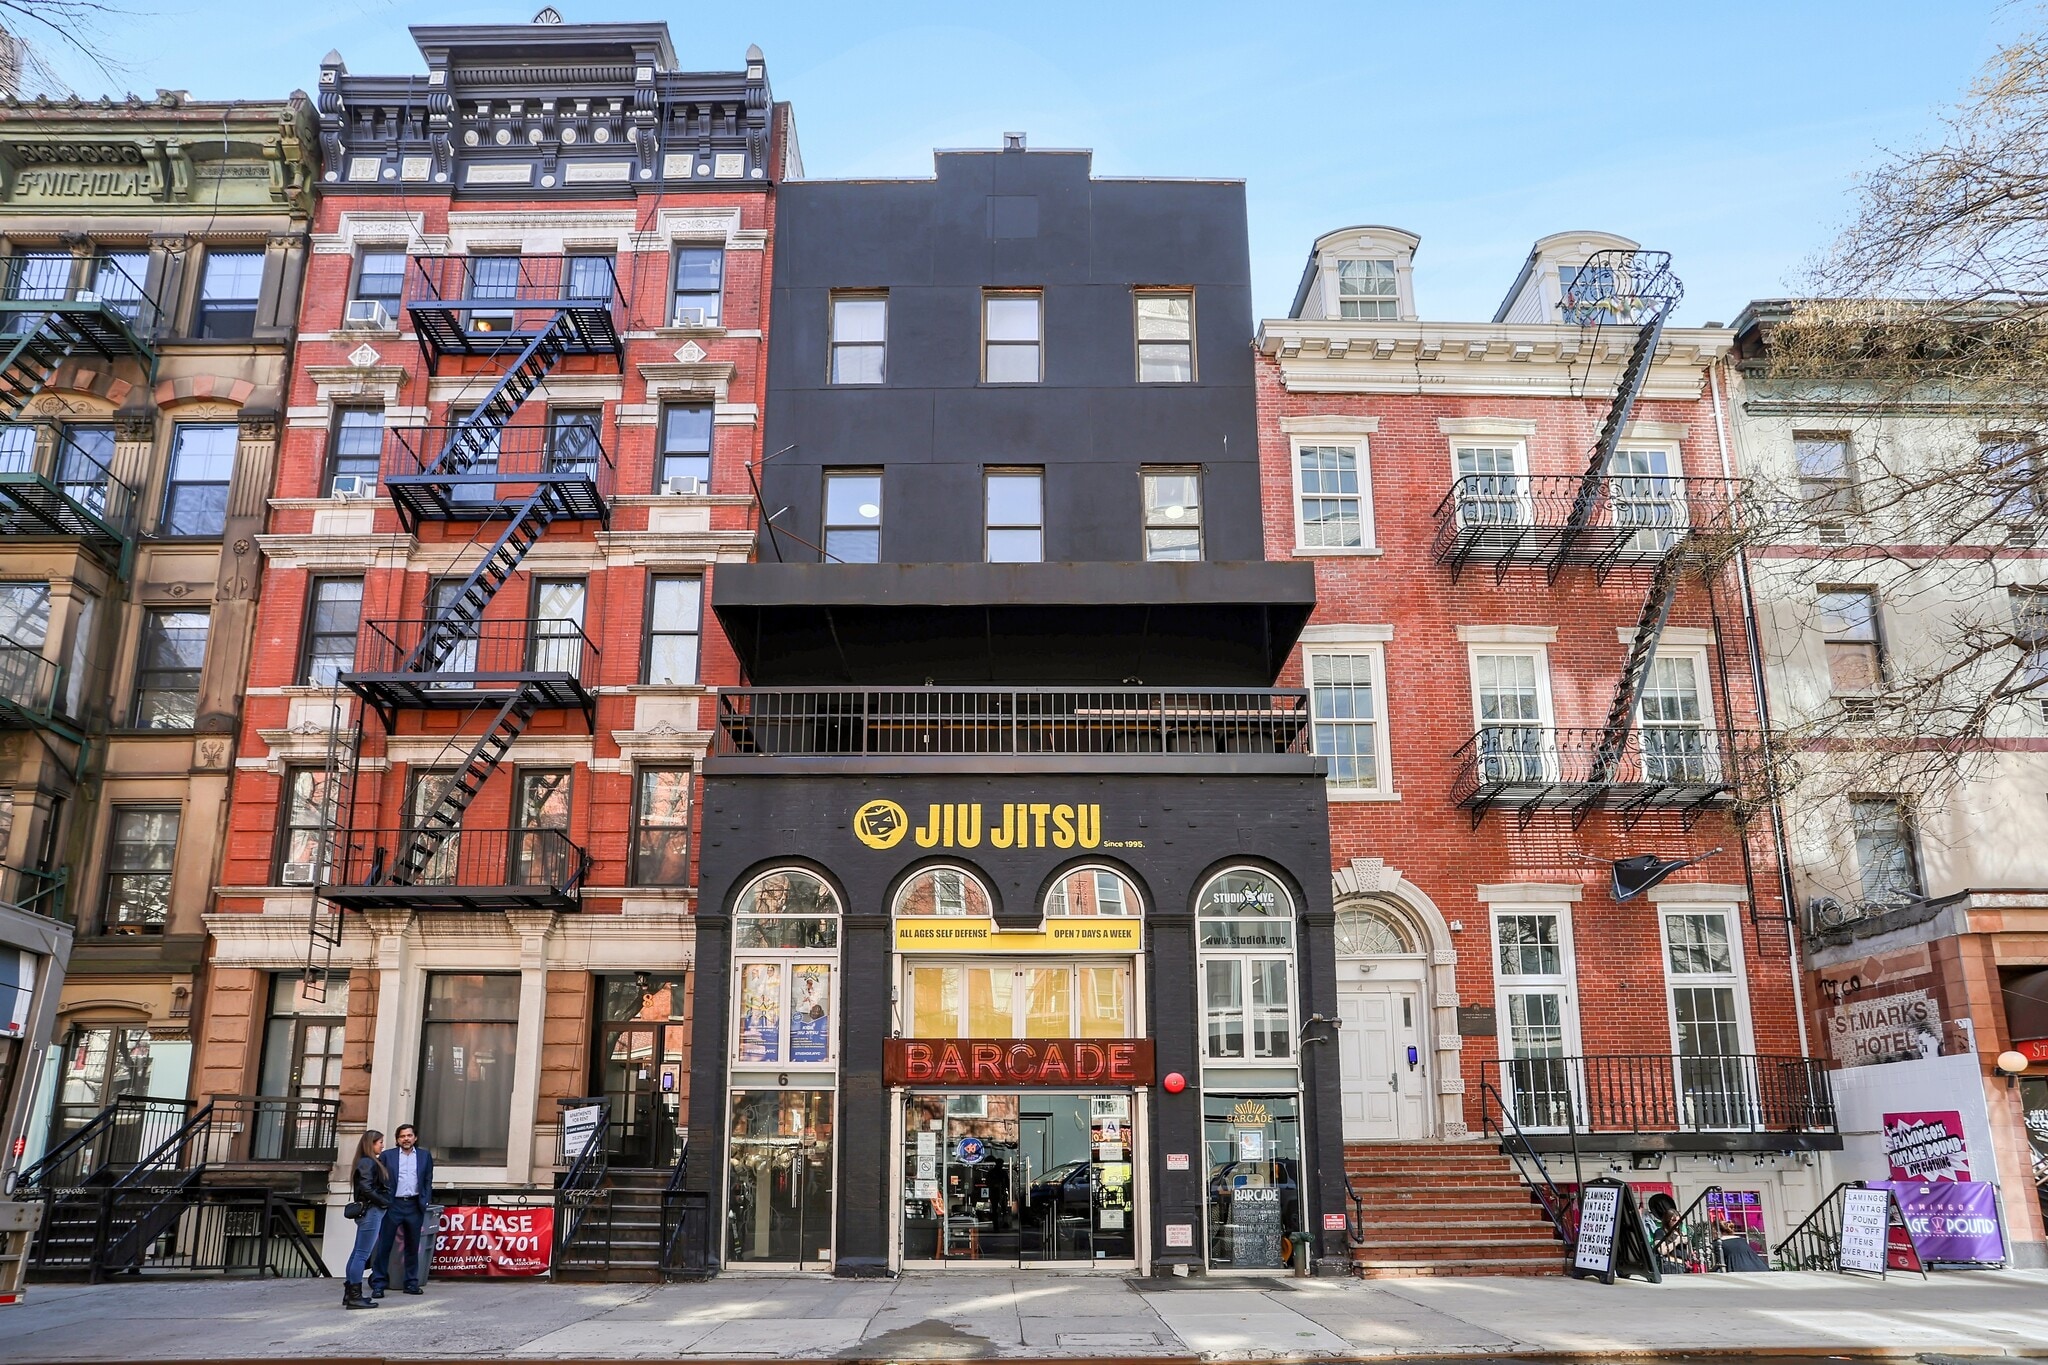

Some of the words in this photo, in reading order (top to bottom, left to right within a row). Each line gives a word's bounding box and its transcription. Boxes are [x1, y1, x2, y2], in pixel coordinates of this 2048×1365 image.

[40, 173, 151, 197] NICHOLAS
[915, 803, 982, 848] JIU
[990, 803, 1101, 849] JITSU
[1124, 840, 1146, 848] 1995.
[1213, 893, 1246, 903] STUDIO
[900, 929, 913, 938] ALL
[914, 929, 934, 938] AGES
[936, 929, 953, 938] SELF
[955, 929, 987, 938] DEFENSE
[1054, 929, 1075, 938] OPEN
[1076, 929, 1080, 938] 7
[1081, 929, 1102, 938] DAYS
[1103, 929, 1108, 938] A
[1110, 929, 1132, 938] WEEK
[643, 994, 653, 1008] 8
[1855, 1032, 1918, 1056] HOTEL
[904, 1043, 1137, 1081] BARCADE
[778, 1073, 788, 1086] 6
[1227, 1114, 1273, 1123] BARCADE
[1888, 1144, 1926, 1167] VINTAGE
[1925, 1136, 1962, 1158] POUND
[1920, 1156, 1951, 1173] CLOTHING
[1234, 1189, 1279, 1201] BARCADE
[1585, 1191, 1615, 1201] FLAMINGOS
[1845, 1193, 1888, 1202] FLAMINGOS
[1584, 1201, 1611, 1212] VINTAGE
[1850, 1204, 1887, 1214] VINTAGE
[438, 1213, 464, 1232] OR
[471, 1213, 533, 1233] LEASE
[1588, 1212, 1609, 1223] POUND
[1852, 1215, 1879, 1225] POUND
[1583, 1222, 1594, 1233] 50%
[1594, 1223, 1606, 1234] OFF
[1864, 1227, 1881, 1236] OFF
[1946, 1218, 1995, 1233] POUND
[435, 1235, 538, 1251] 8.770.7701
[1580, 1233, 1596, 1244] ITEMS
[1596, 1235, 1613, 1246] OVER
[1849, 1237, 1874, 1247] ITEMS
[1579, 1244, 1587, 1254] 2.5
[1588, 1245, 1611, 1257] POUNDS
[1841, 1258, 1861, 1268] COME
[1869, 1262, 1879, 1270] IN
